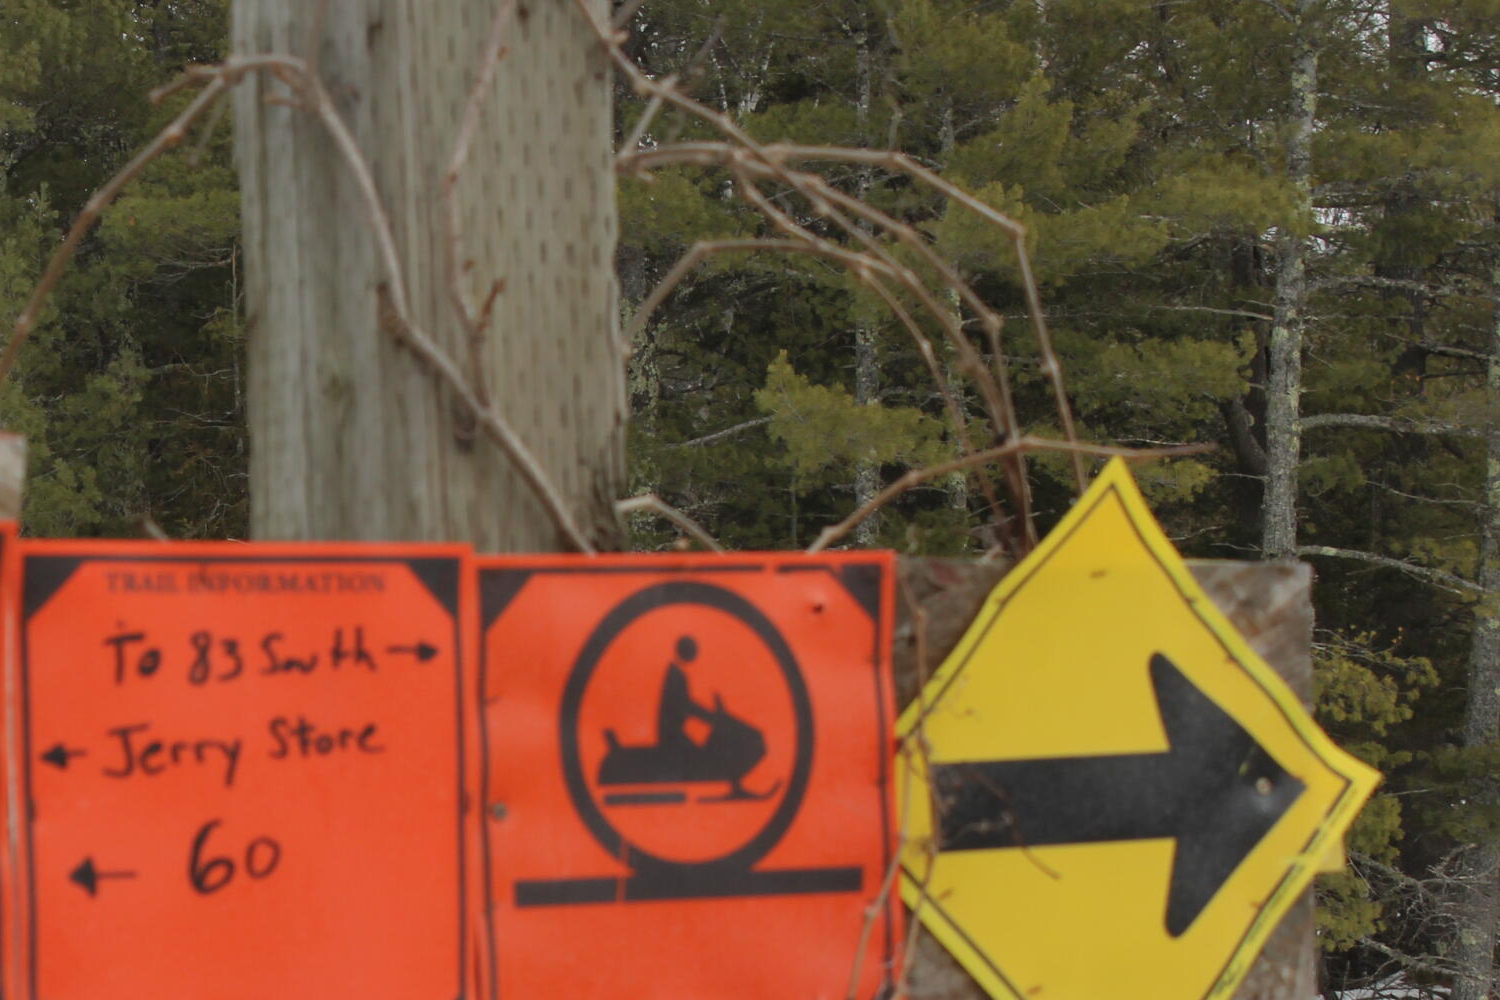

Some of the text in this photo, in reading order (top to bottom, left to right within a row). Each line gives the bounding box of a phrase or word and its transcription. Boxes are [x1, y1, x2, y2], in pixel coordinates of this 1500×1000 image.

[106, 571, 387, 594] TRAIL INFORMATION
[103, 629, 162, 687] To
[187, 630, 244, 686] 83
[101, 715, 386, 789] Jerry Store
[187, 818, 282, 897] 60
